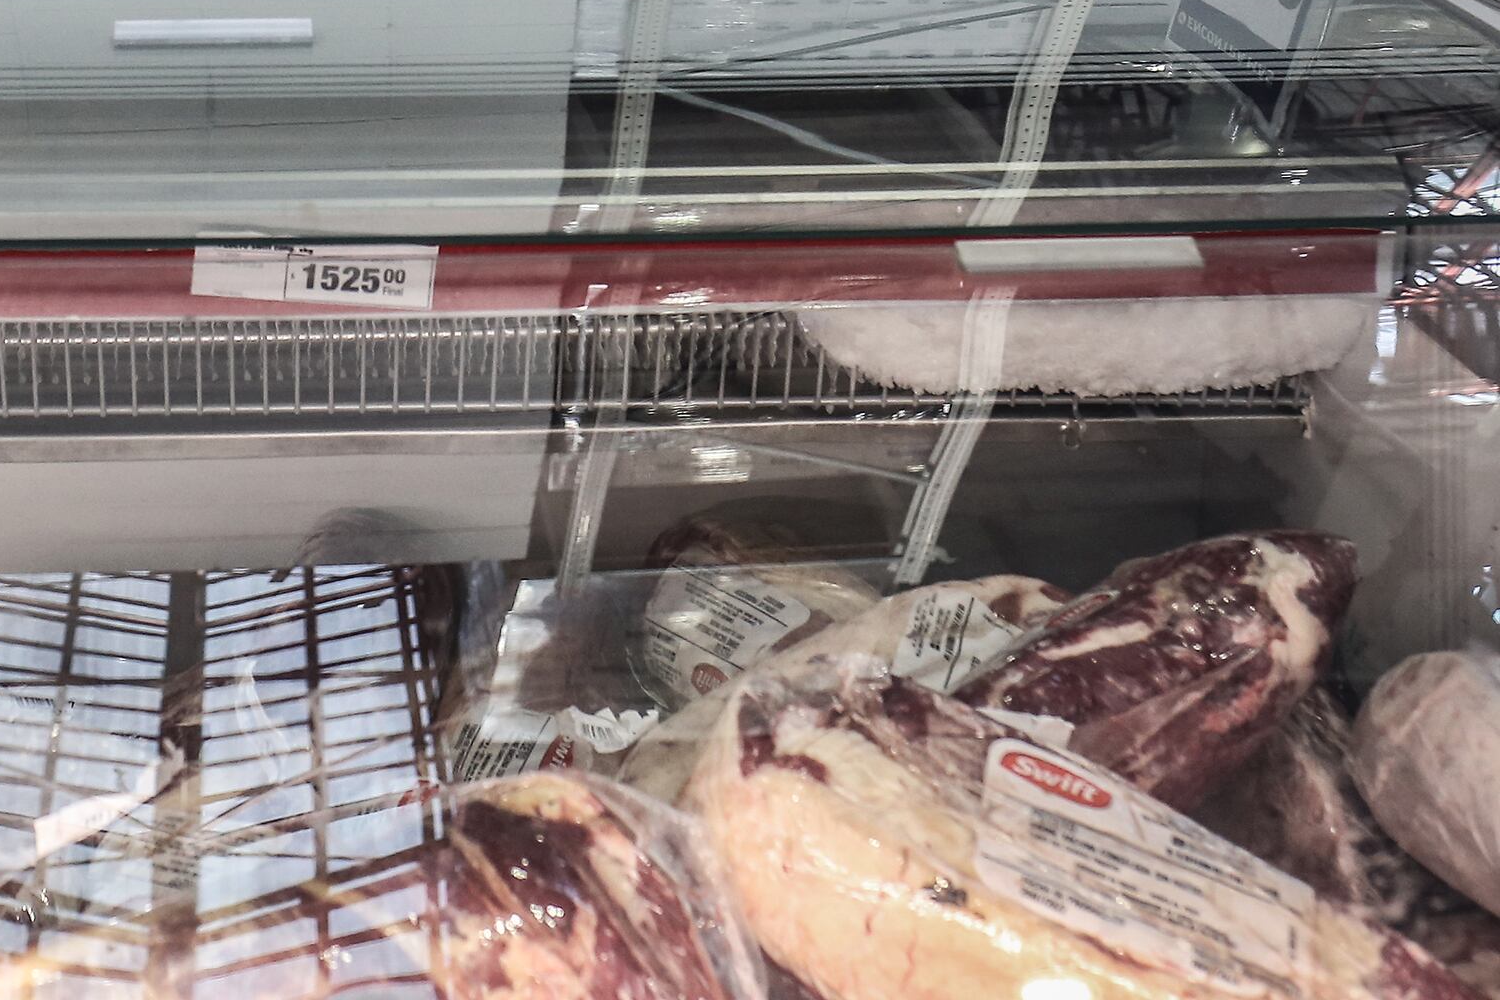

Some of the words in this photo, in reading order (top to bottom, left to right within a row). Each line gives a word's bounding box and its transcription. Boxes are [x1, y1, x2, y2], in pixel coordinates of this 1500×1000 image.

[302, 263, 381, 293] 1525
[383, 268, 406, 284] 00
[382, 286, 405, 297] Final
[1011, 755, 1100, 802] Swift
